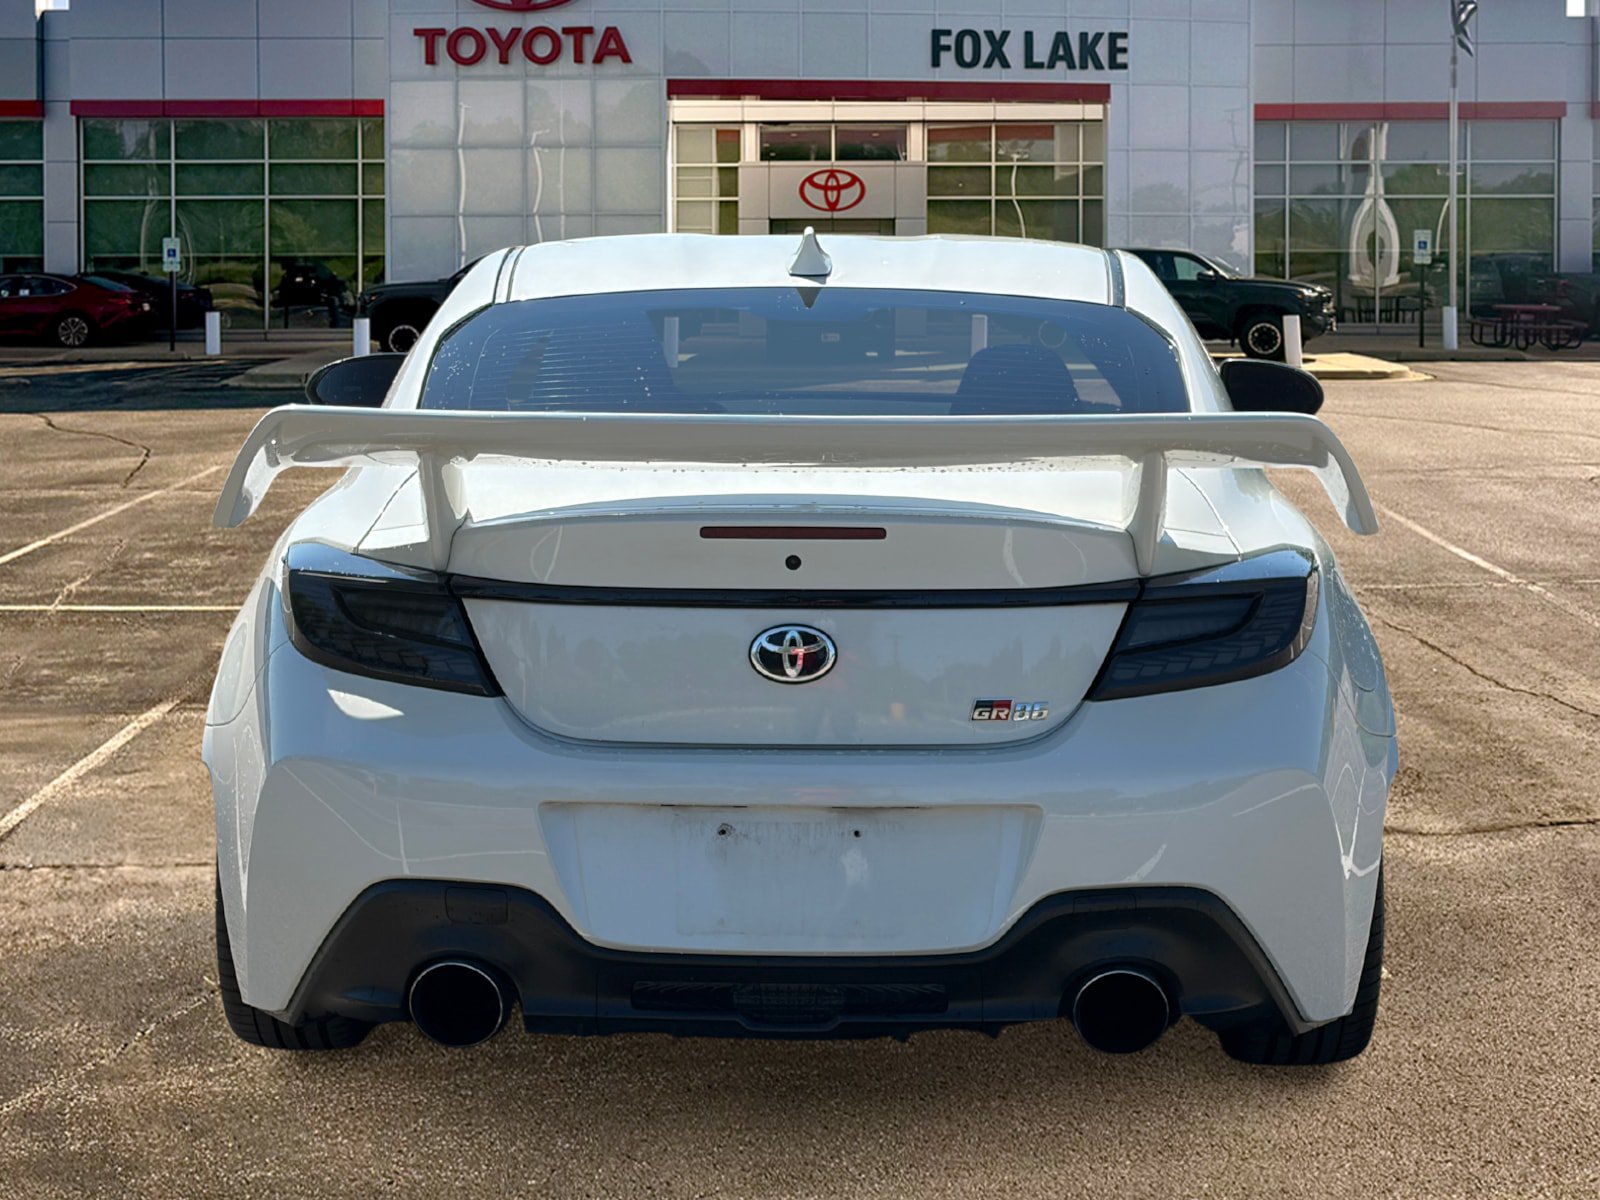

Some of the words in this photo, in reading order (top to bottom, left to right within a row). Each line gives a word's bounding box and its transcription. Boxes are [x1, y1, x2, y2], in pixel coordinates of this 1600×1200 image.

[413, 26, 632, 65] TOYOTA
[931, 29, 1012, 69] FOX
[1024, 30, 1129, 71] LAKE
